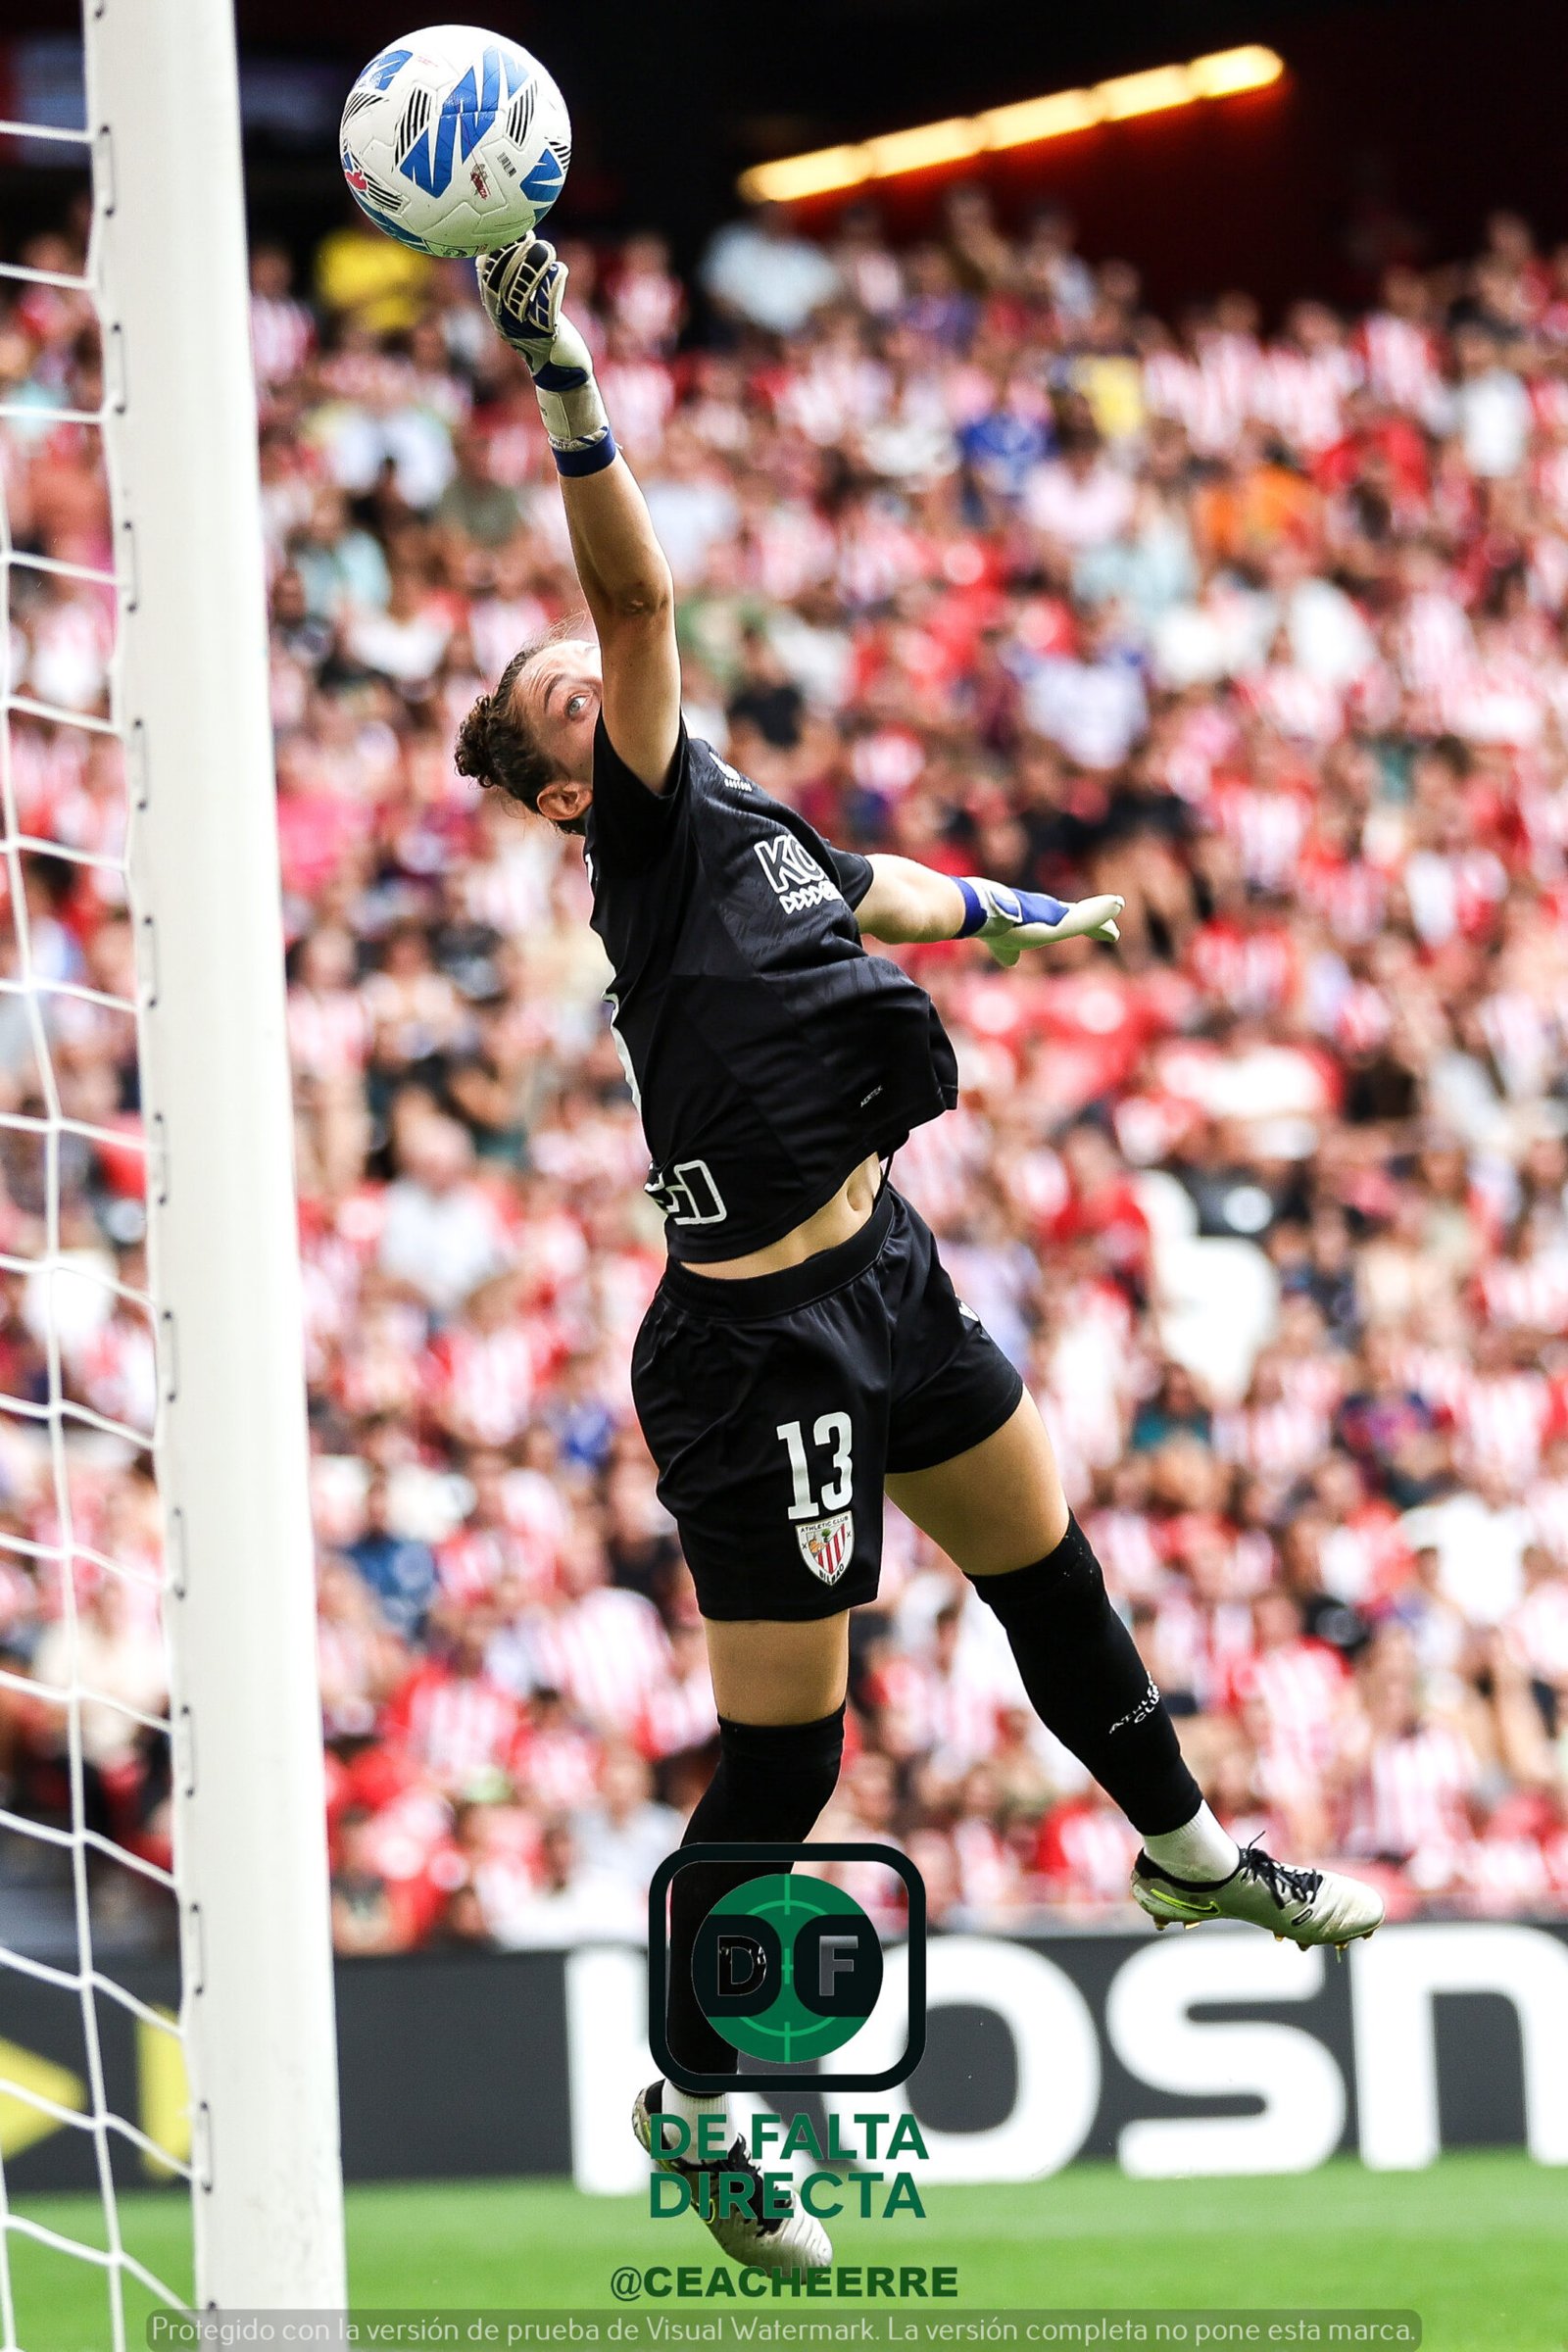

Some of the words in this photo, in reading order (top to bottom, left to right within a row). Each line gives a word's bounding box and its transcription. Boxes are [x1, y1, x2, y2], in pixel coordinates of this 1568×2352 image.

[777, 1411, 853, 1520] 13
[800, 1521, 832, 1533] ATHLETIC
[832, 1515, 849, 1525] CLUB
[818, 1563, 845, 1585] BILBAO
